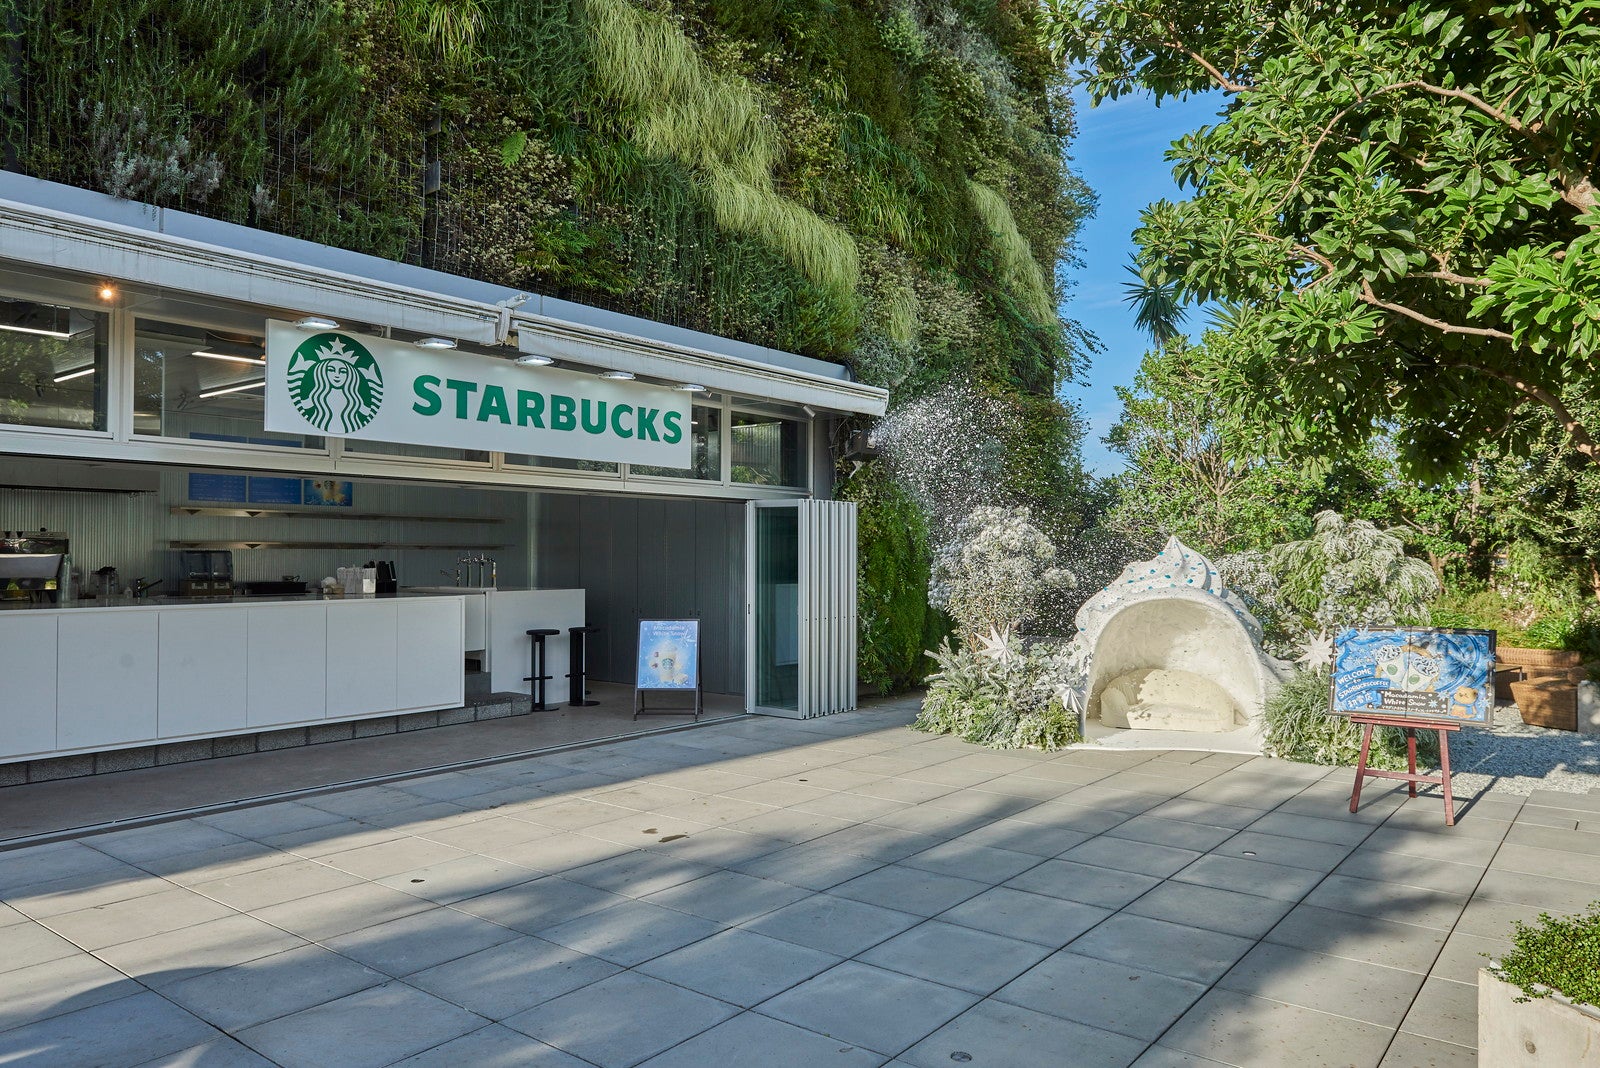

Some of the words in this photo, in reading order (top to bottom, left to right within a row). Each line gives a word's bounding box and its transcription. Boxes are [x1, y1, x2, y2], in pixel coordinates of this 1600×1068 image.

[412, 374, 682, 445] STARBUCKS
[1337, 667, 1372, 685] WELCOME
[1384, 691, 1426, 700] Macadamia
[1384, 697, 1406, 705] White
[1408, 698, 1426, 707] Snow
